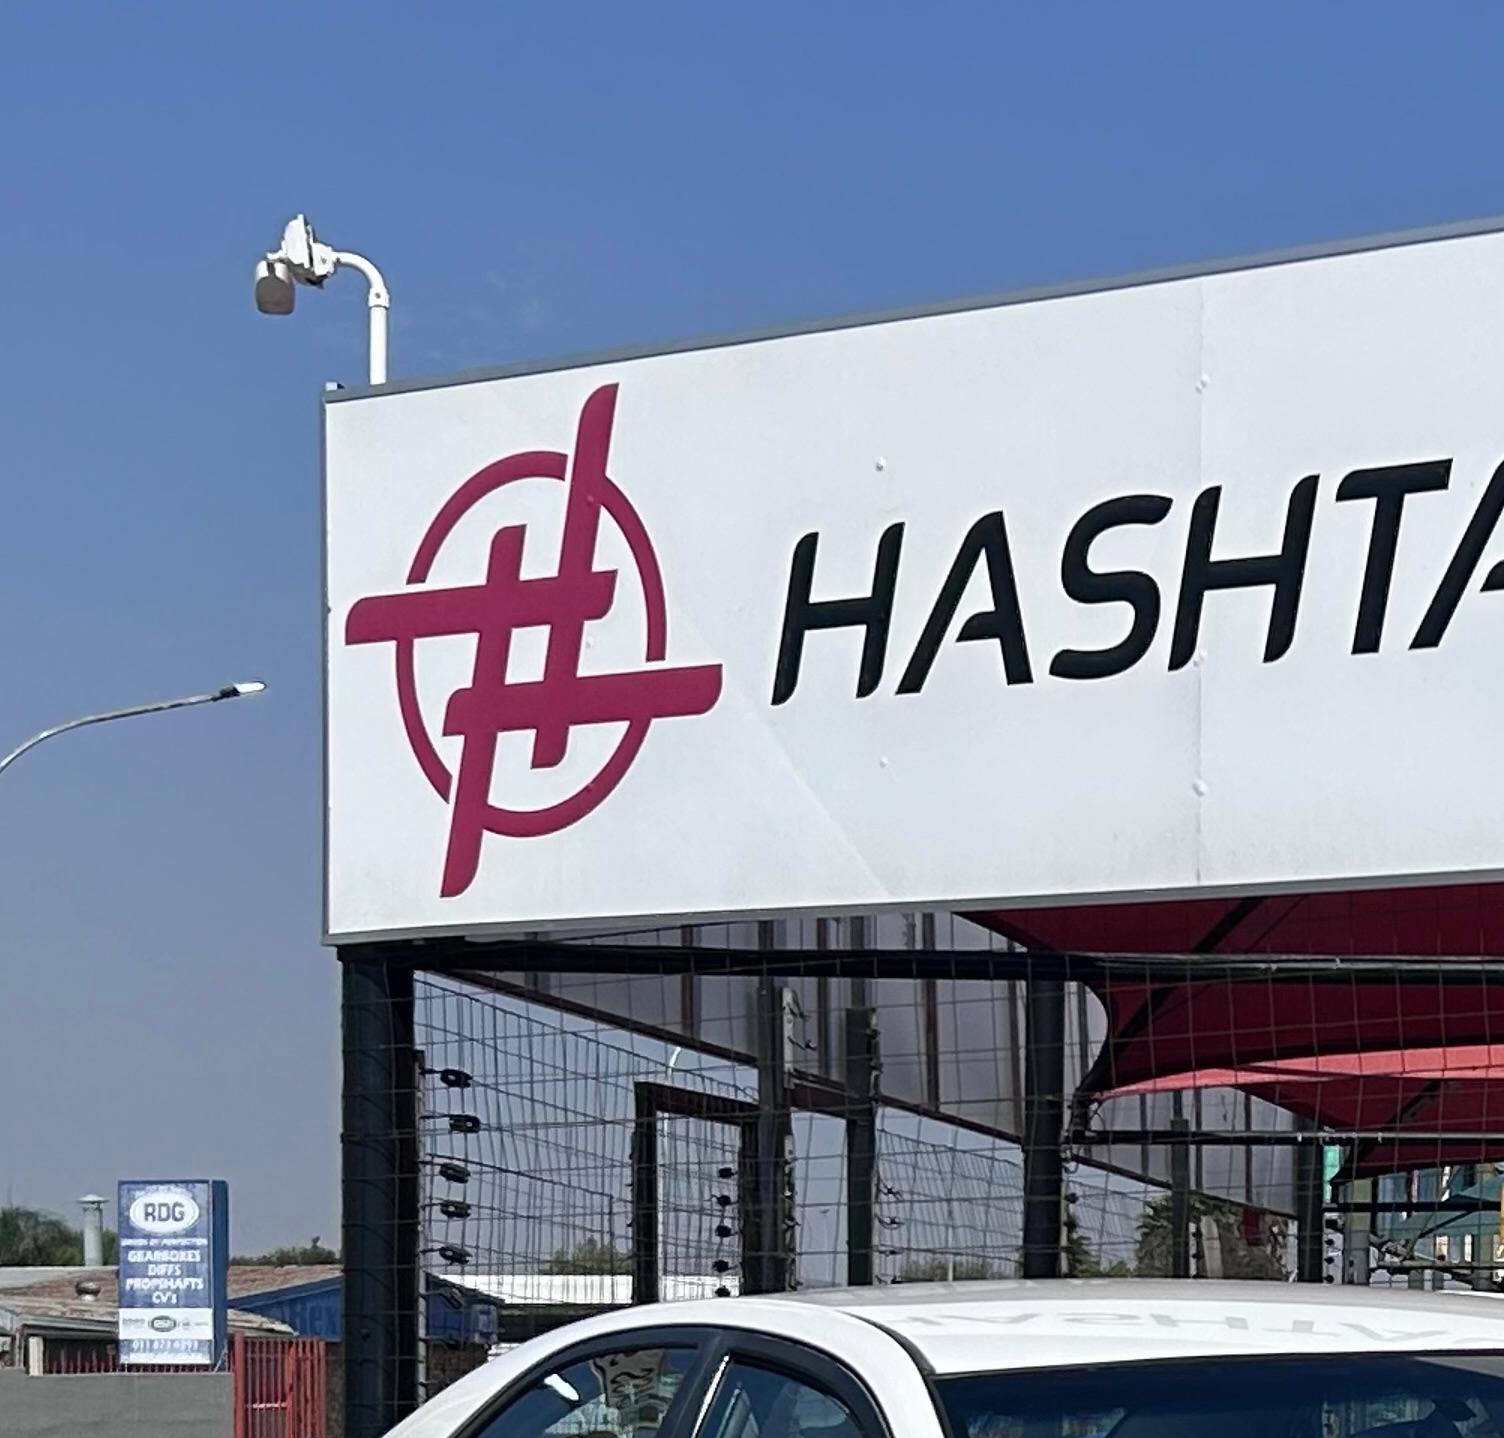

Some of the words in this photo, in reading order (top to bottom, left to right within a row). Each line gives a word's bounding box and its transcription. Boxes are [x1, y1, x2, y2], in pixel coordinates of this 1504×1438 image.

[144, 1202, 185, 1222] RDG
[128, 1250, 201, 1263] GEARBOXES
[148, 1264, 182, 1276] DIFFS
